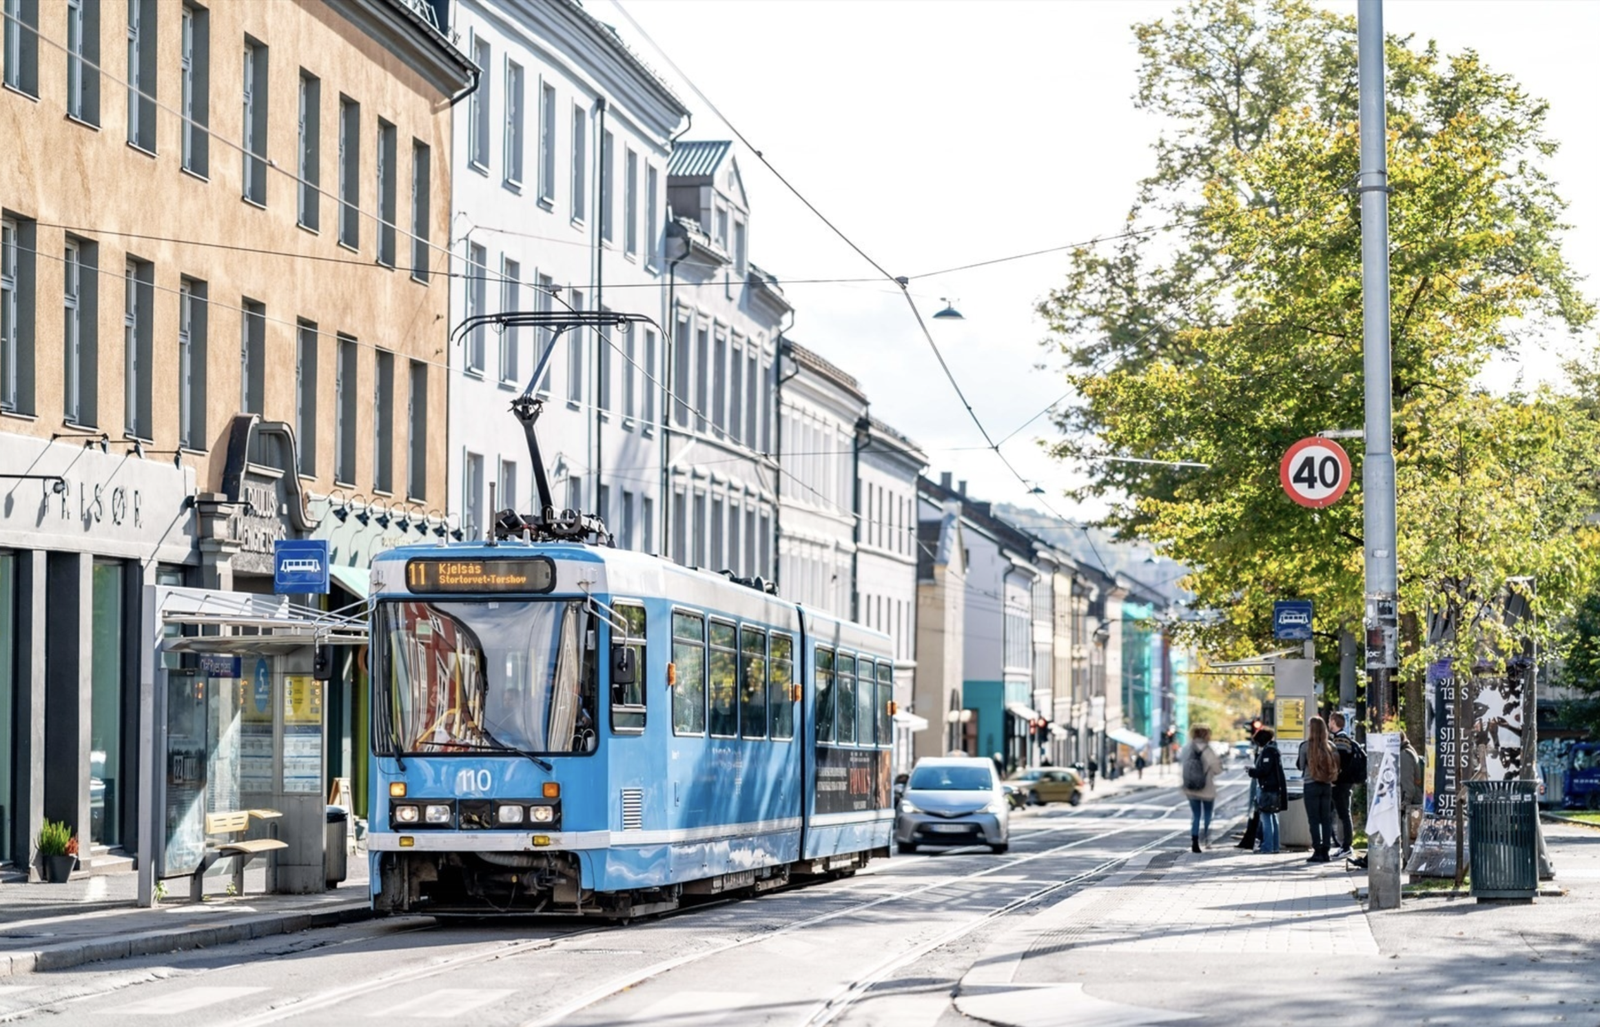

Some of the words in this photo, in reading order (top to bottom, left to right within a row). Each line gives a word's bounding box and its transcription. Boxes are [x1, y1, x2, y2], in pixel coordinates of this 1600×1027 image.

[1293, 455, 1340, 489] 40
[408, 563, 426, 586] 11
[438, 564, 482, 576] Kjelsås
[458, 769, 491, 791] 110
